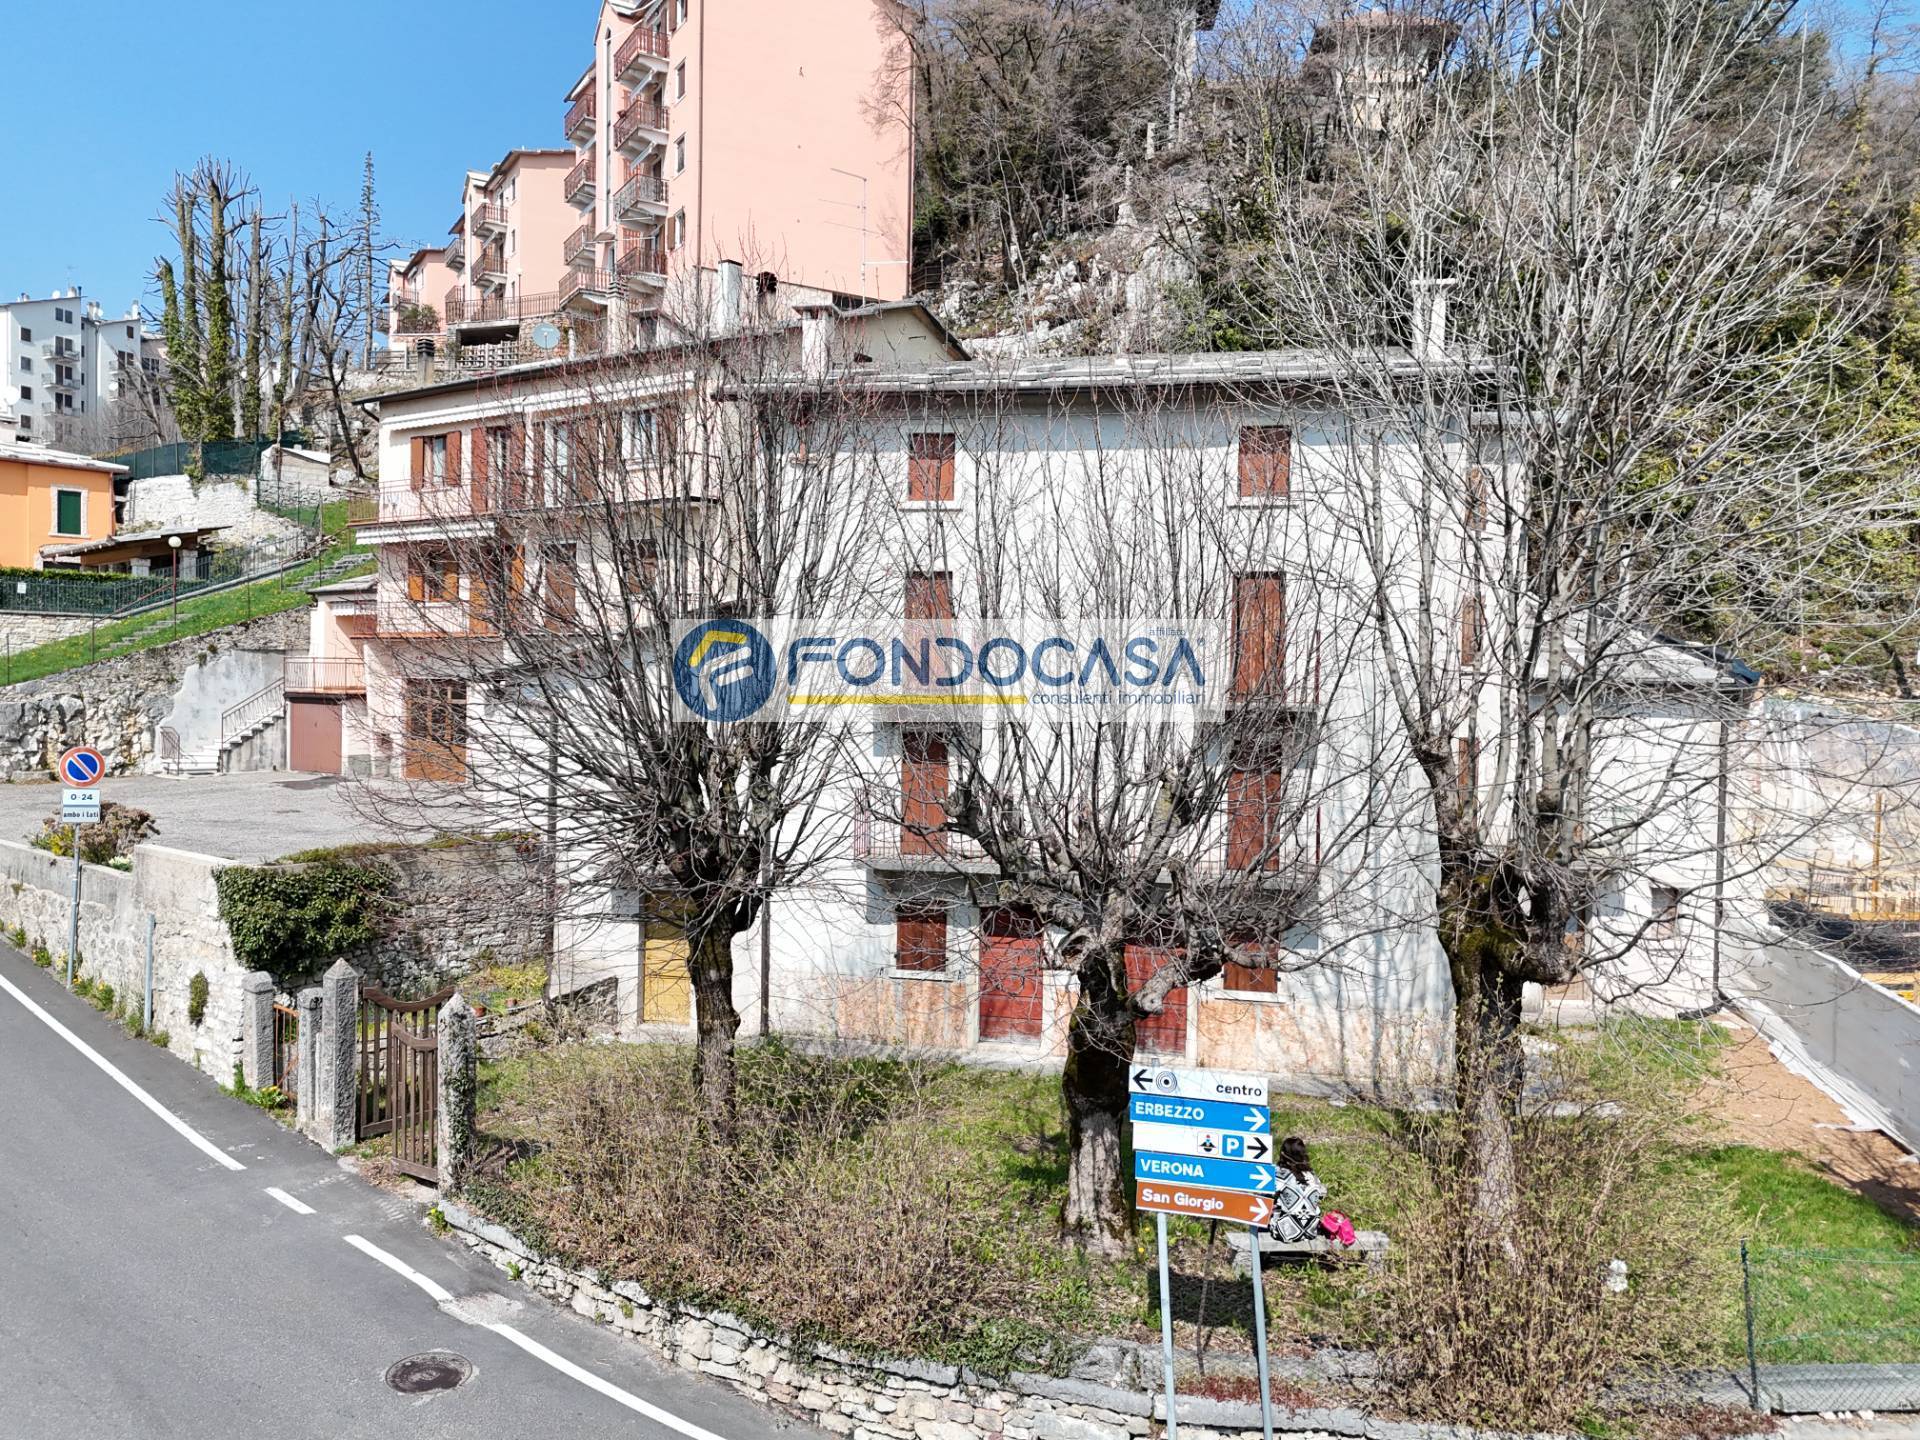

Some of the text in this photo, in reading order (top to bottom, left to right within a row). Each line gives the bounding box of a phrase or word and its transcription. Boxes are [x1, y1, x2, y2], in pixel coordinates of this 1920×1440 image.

[1216, 1083, 1262, 1097] centro
[1135, 1101, 1205, 1121] ERBEZZO
[1226, 1138, 1240, 1154] P
[1140, 1158, 1204, 1178] VERONA
[1142, 1189, 1224, 1211] San Giorgio
